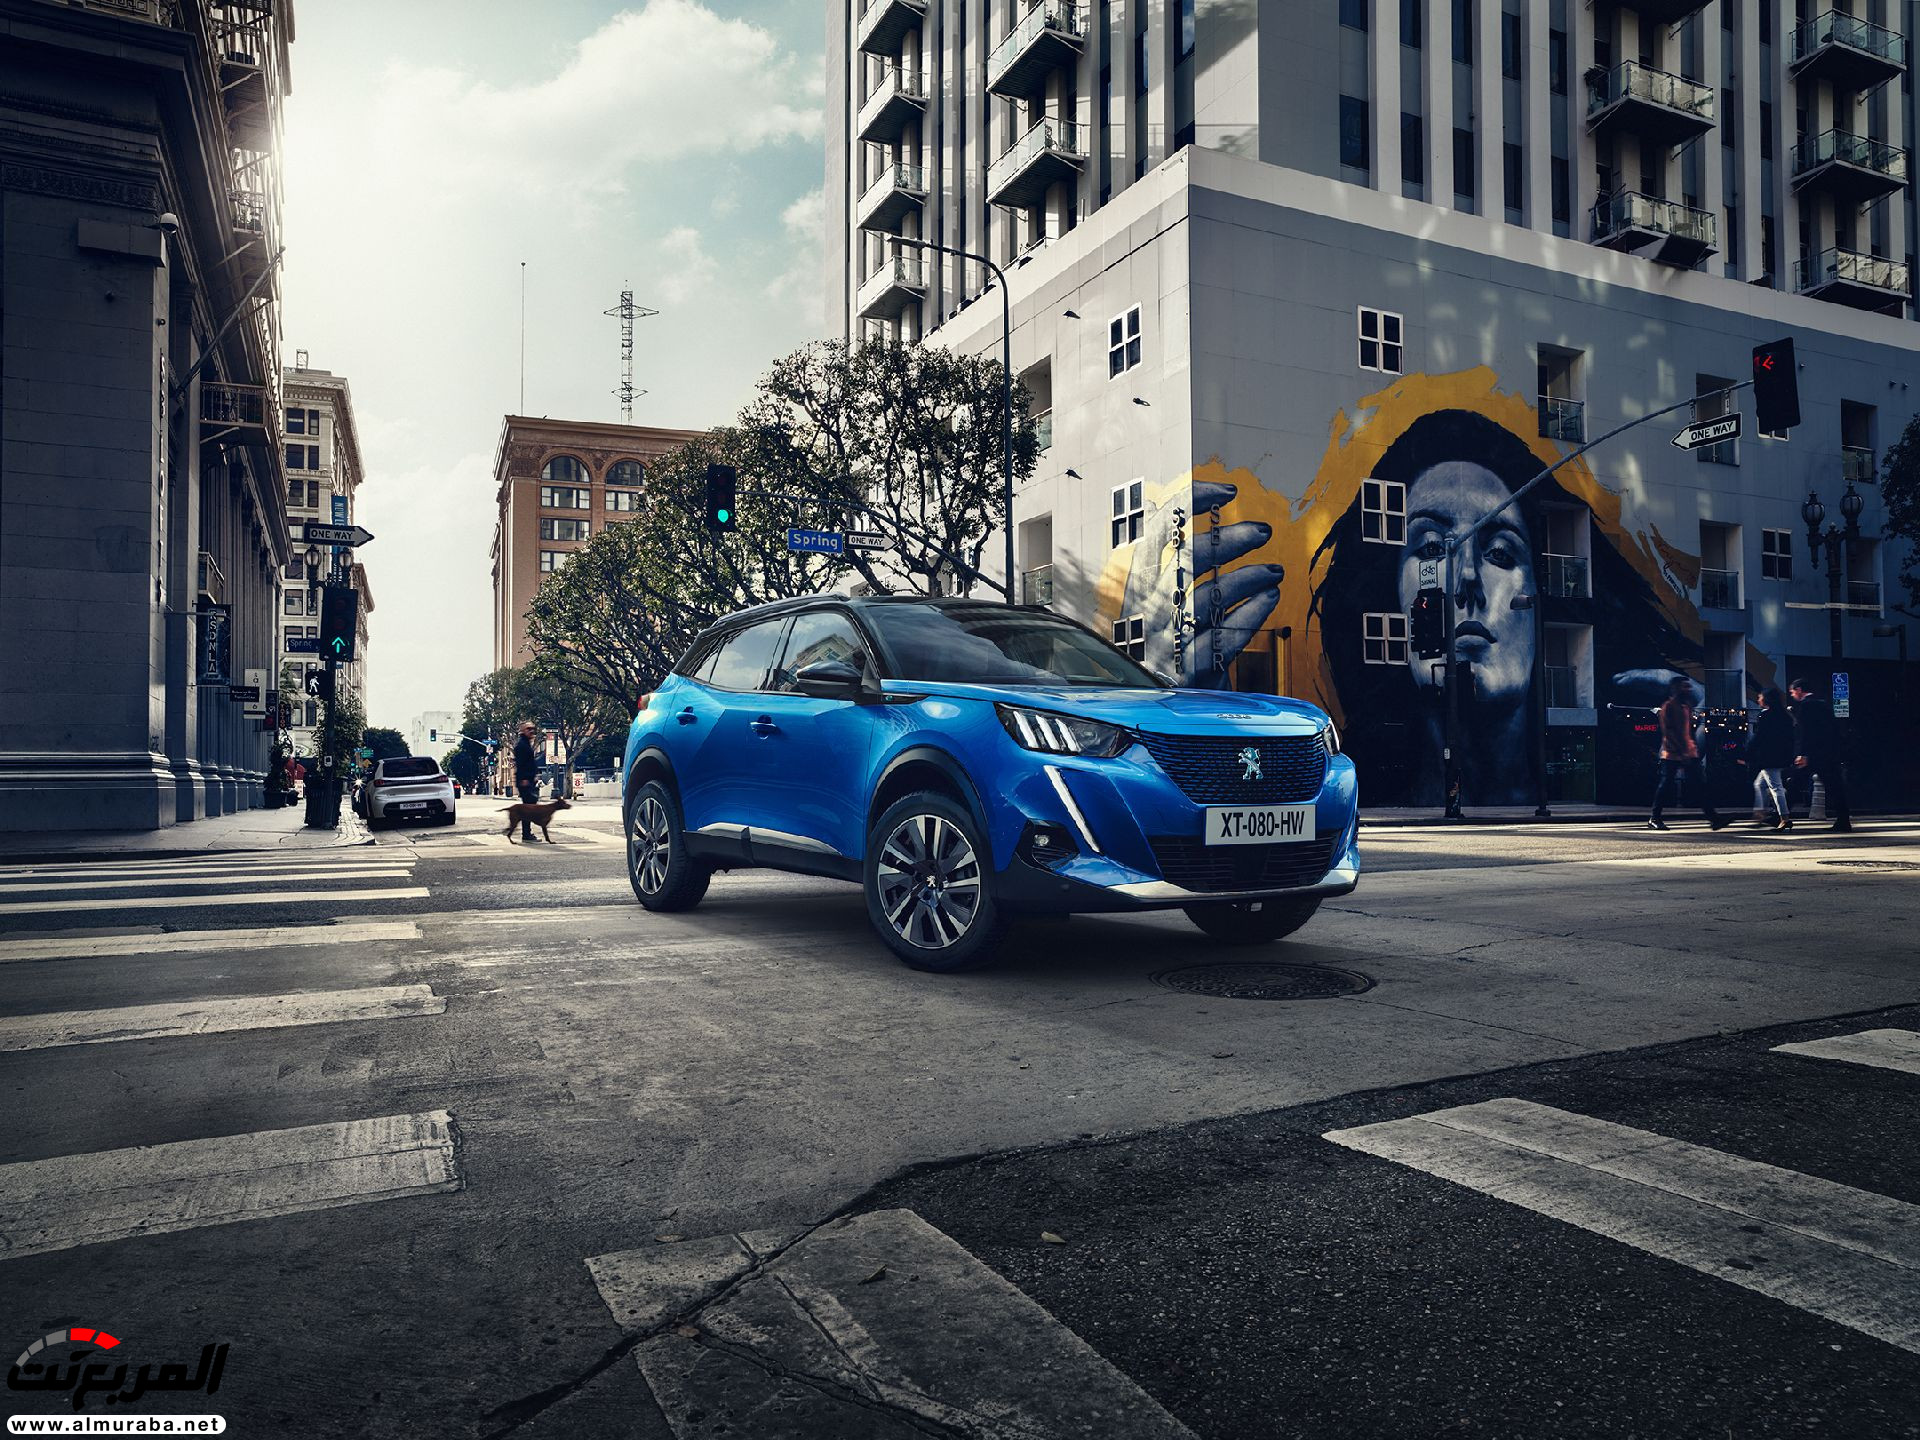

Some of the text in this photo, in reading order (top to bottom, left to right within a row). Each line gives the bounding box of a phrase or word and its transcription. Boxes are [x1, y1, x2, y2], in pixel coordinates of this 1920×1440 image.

[1691, 421, 1734, 441] ONE WAY
[311, 529, 353, 540] ONE WAY
[793, 533, 838, 550] Spring
[868, 538, 884, 546] WAY
[1421, 578, 1436, 586] SIGNAL
[1209, 564, 1226, 672] TOWER
[1634, 724, 1657, 732] MARKE
[1220, 811, 1305, 837] XT-080-HW
